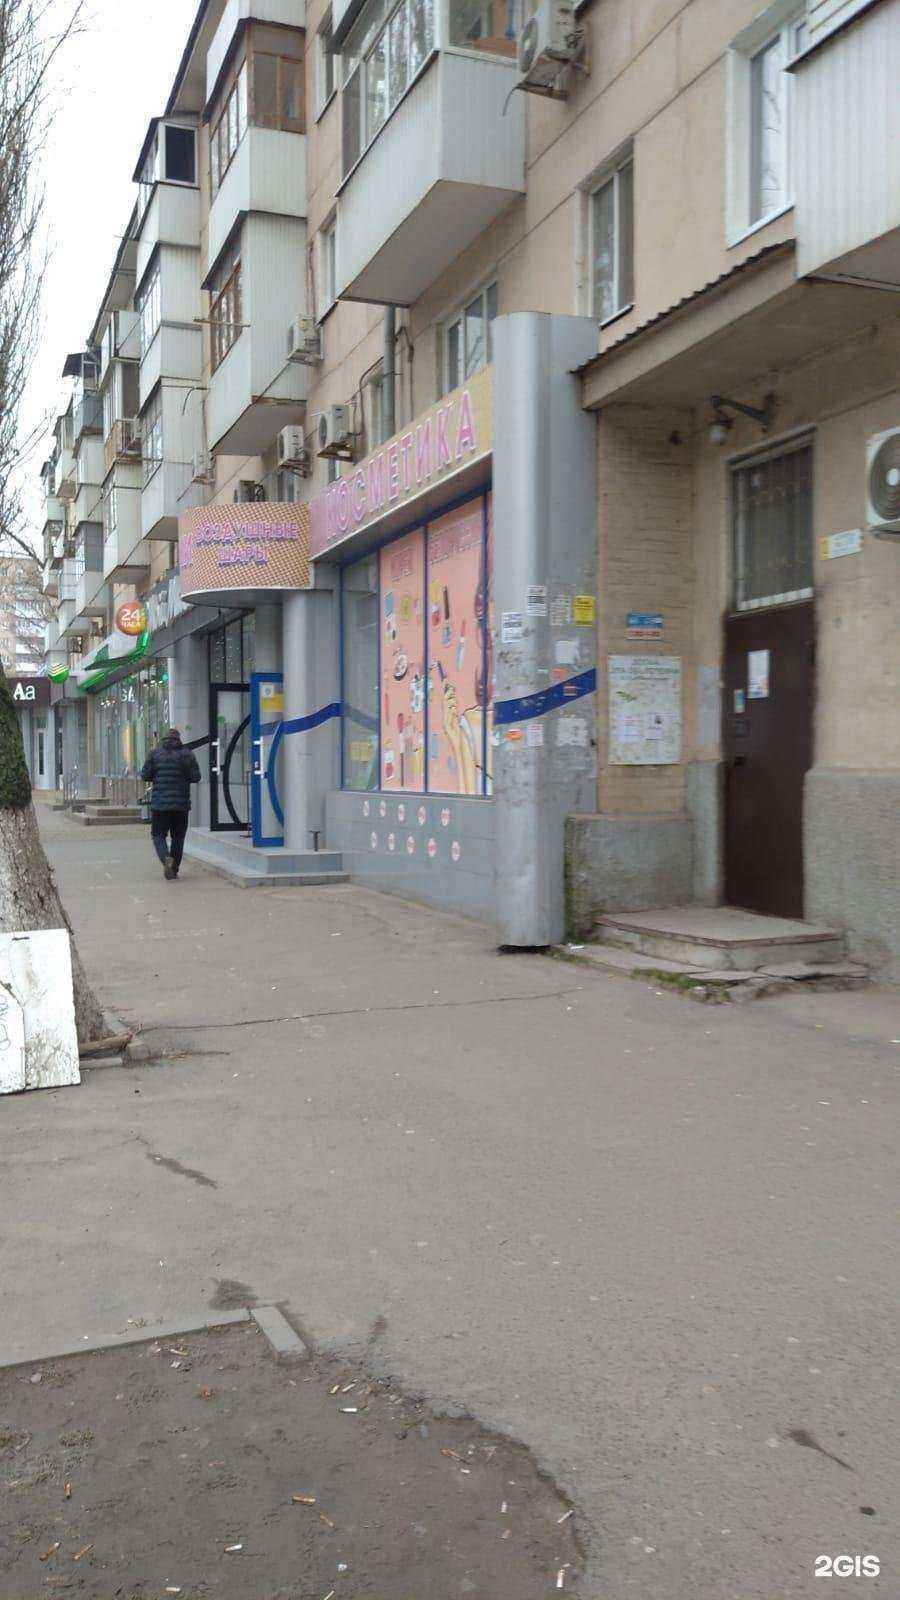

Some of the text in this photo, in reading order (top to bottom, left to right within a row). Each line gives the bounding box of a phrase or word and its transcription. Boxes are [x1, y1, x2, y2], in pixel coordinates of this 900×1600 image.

[326, 389, 477, 543] КОСМЕТИКА
[196, 521, 299, 545] ВОЗДУШНЫЕ
[218, 546, 268, 567] ШАРЫ
